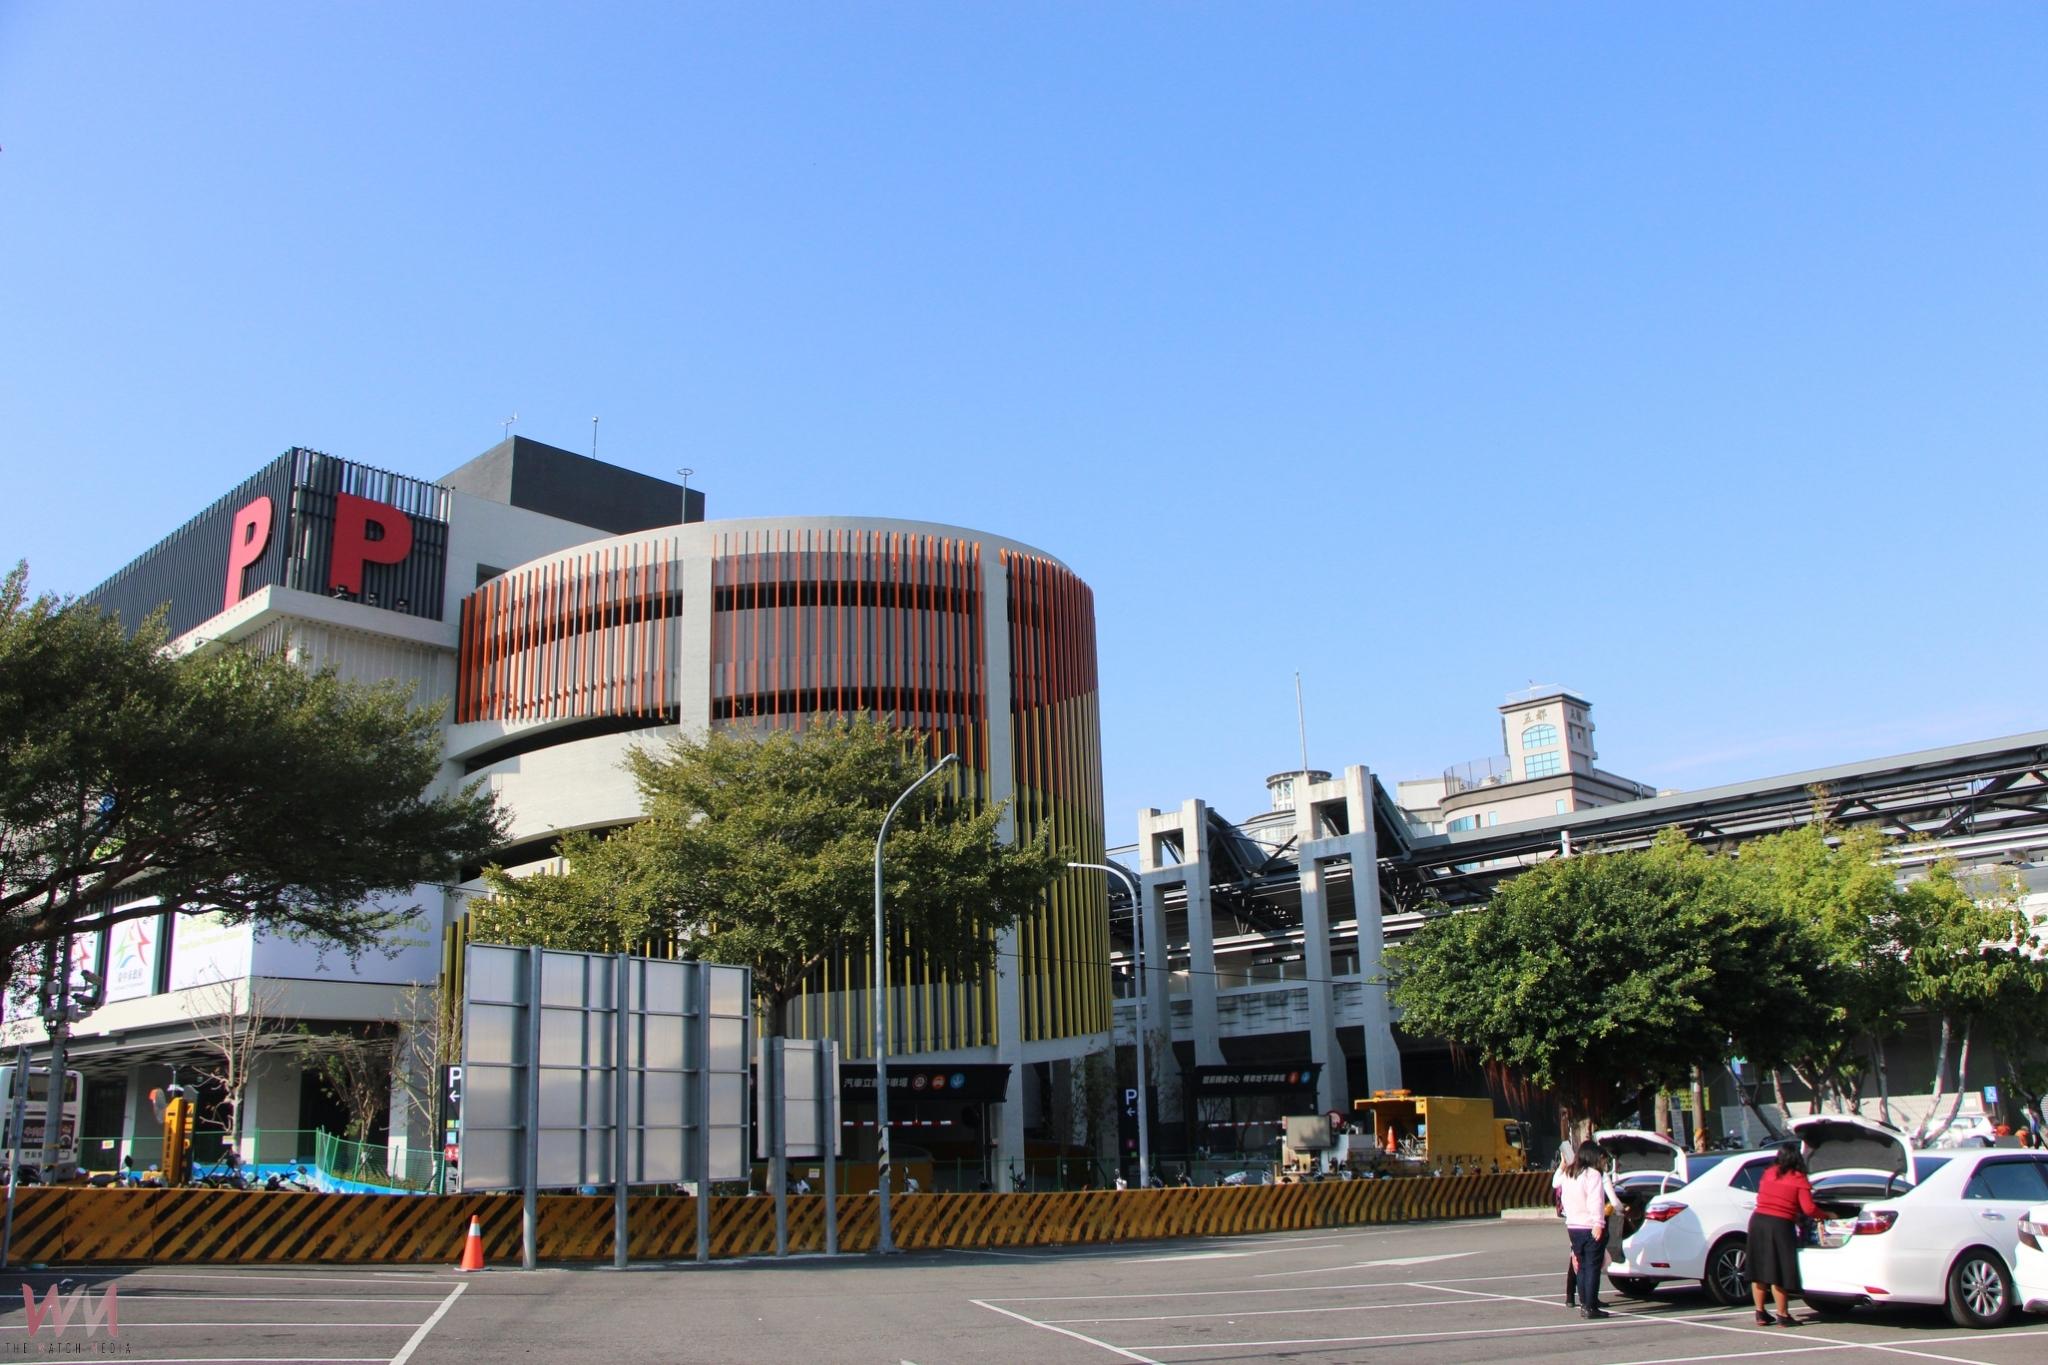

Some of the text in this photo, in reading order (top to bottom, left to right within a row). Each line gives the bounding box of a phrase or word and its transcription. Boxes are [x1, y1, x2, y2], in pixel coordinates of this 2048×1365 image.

[224, 496, 272, 611] P
[329, 492, 413, 594] P
[449, 1067, 461, 1088] P
[1125, 1088, 1137, 1106] P
